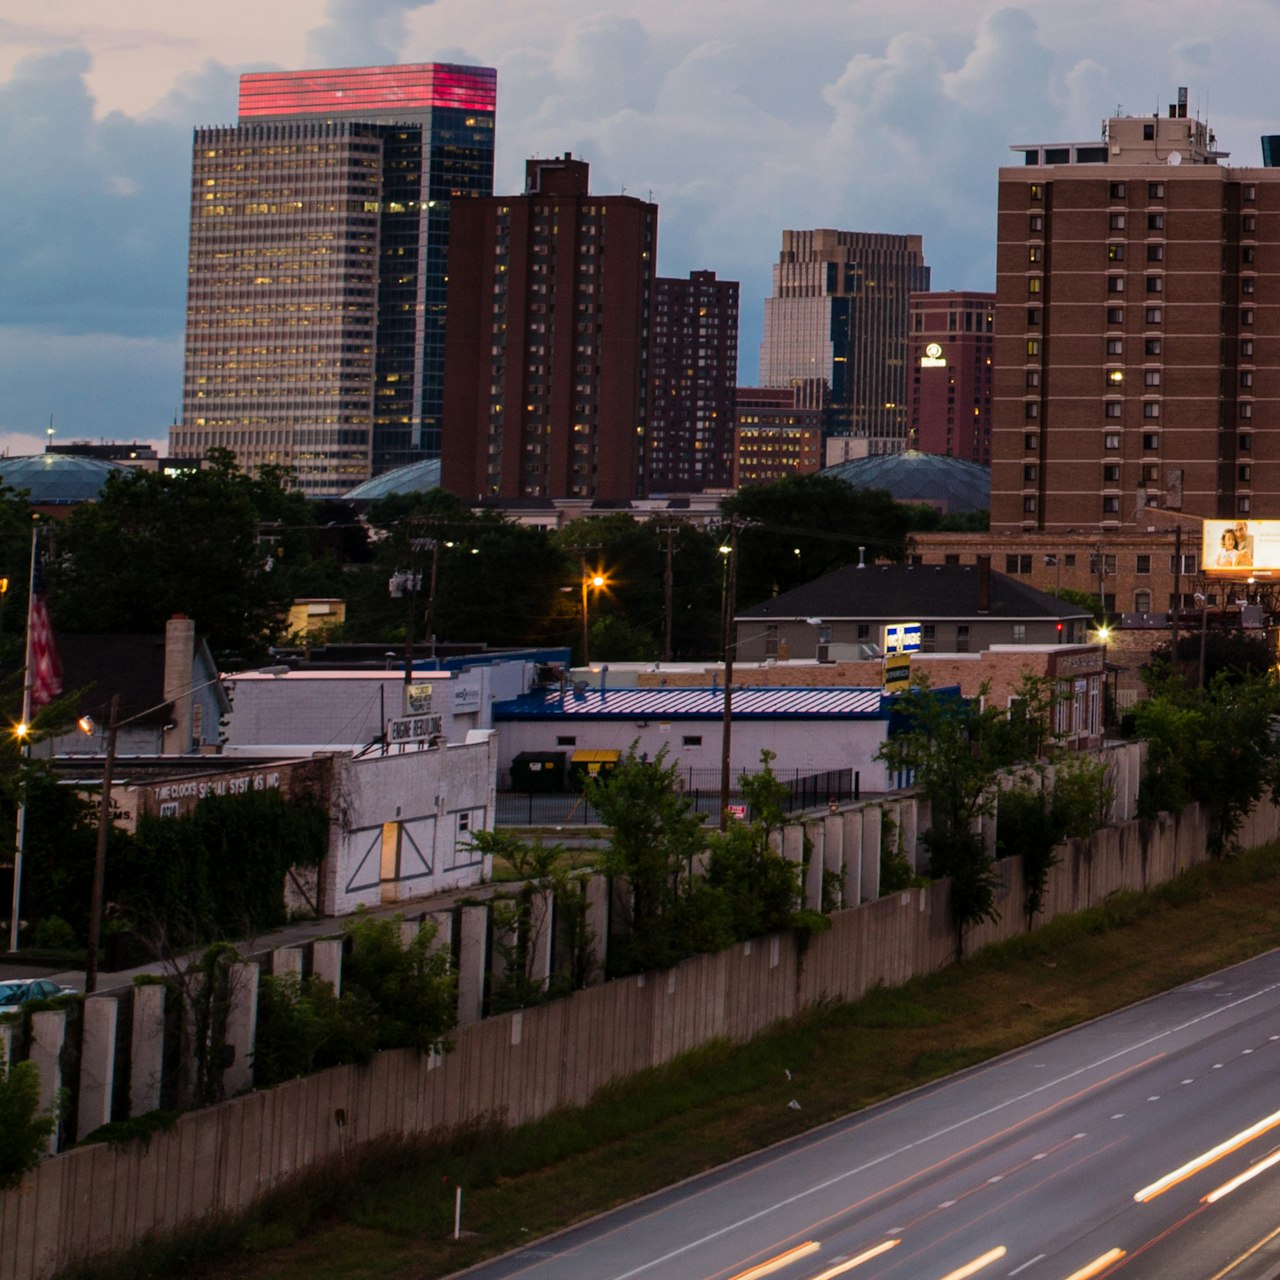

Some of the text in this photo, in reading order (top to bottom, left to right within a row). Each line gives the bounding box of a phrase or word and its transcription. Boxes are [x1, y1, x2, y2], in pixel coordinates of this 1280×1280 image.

[393, 715, 441, 739] ENGINE REBUILDING
[171, 782, 196, 798] CLOCKS
